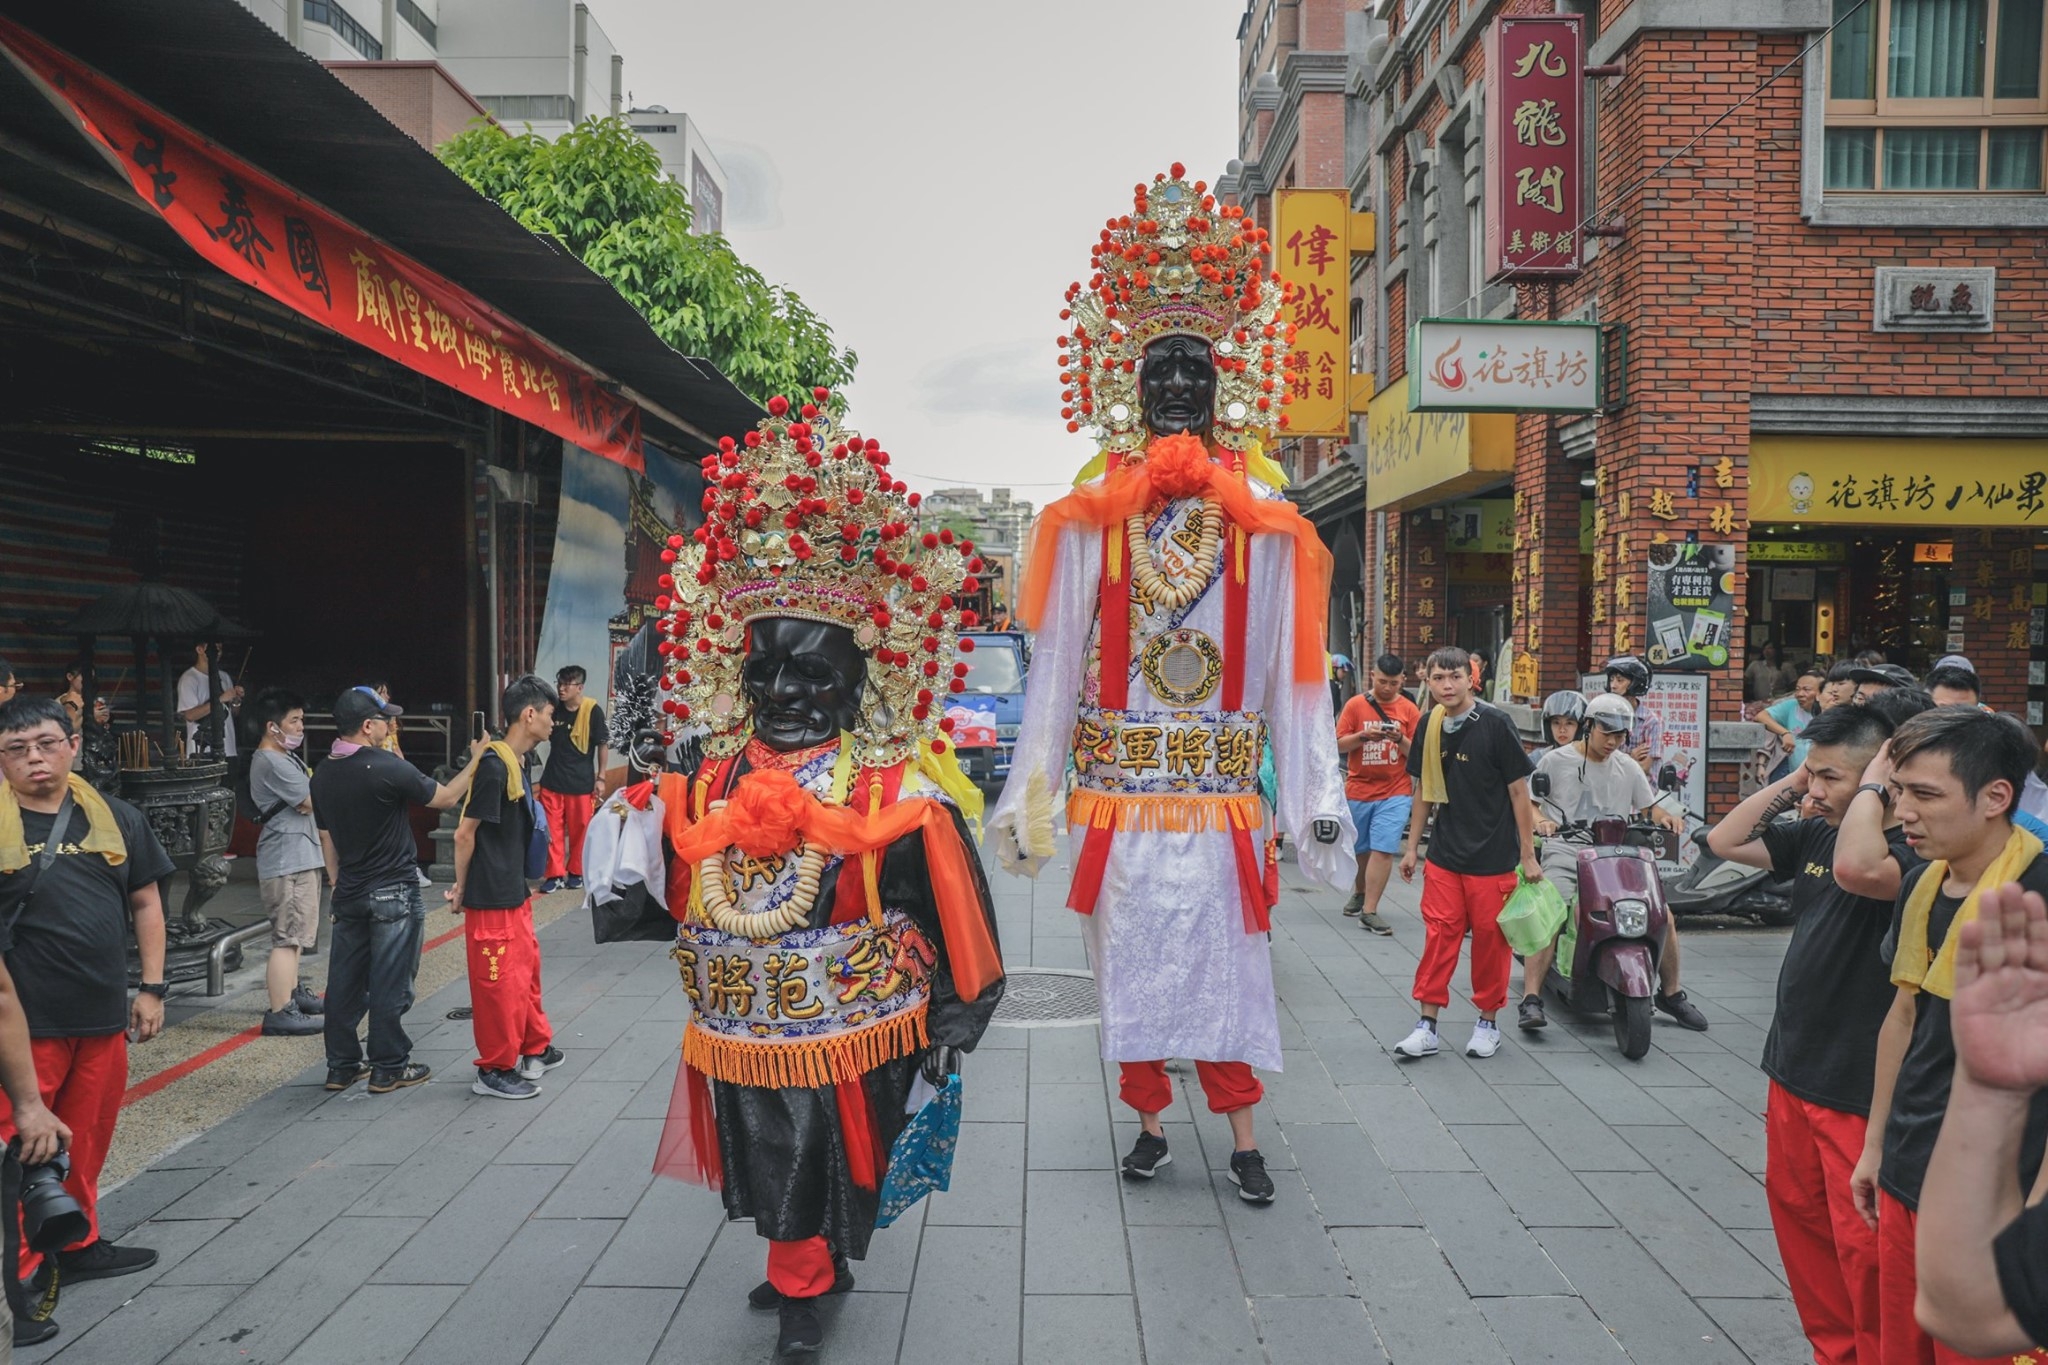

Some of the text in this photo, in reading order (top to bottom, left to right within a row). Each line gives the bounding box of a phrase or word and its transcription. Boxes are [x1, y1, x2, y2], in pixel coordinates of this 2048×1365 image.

[1506, 228, 1575, 255] 美術館
[1286, 224, 1340, 336] 偉誠
[1291, 350, 1312, 400] 藥材
[1316, 351, 1337, 401] 公司
[1473, 343, 1589, 391] 花旗坊
[1370, 411, 1411, 476] 花旗坊
[1709, 456, 1740, 535] 吉林
[1825, 470, 2048, 521] 花旗坊 八仙果
[1671, 575, 1712, 586] 有專利書
[1671, 585, 1712, 596] 才是正貨
[1649, 680, 1702, 691] 堂命理館
[1119, 726, 1254, 778] 謝將軍
[1362, 751, 1382, 760] SAUCE
[1363, 742, 1386, 752] PEPPER
[1662, 731, 1692, 748] 幸福
[678, 948, 824, 1021] 范將軍
